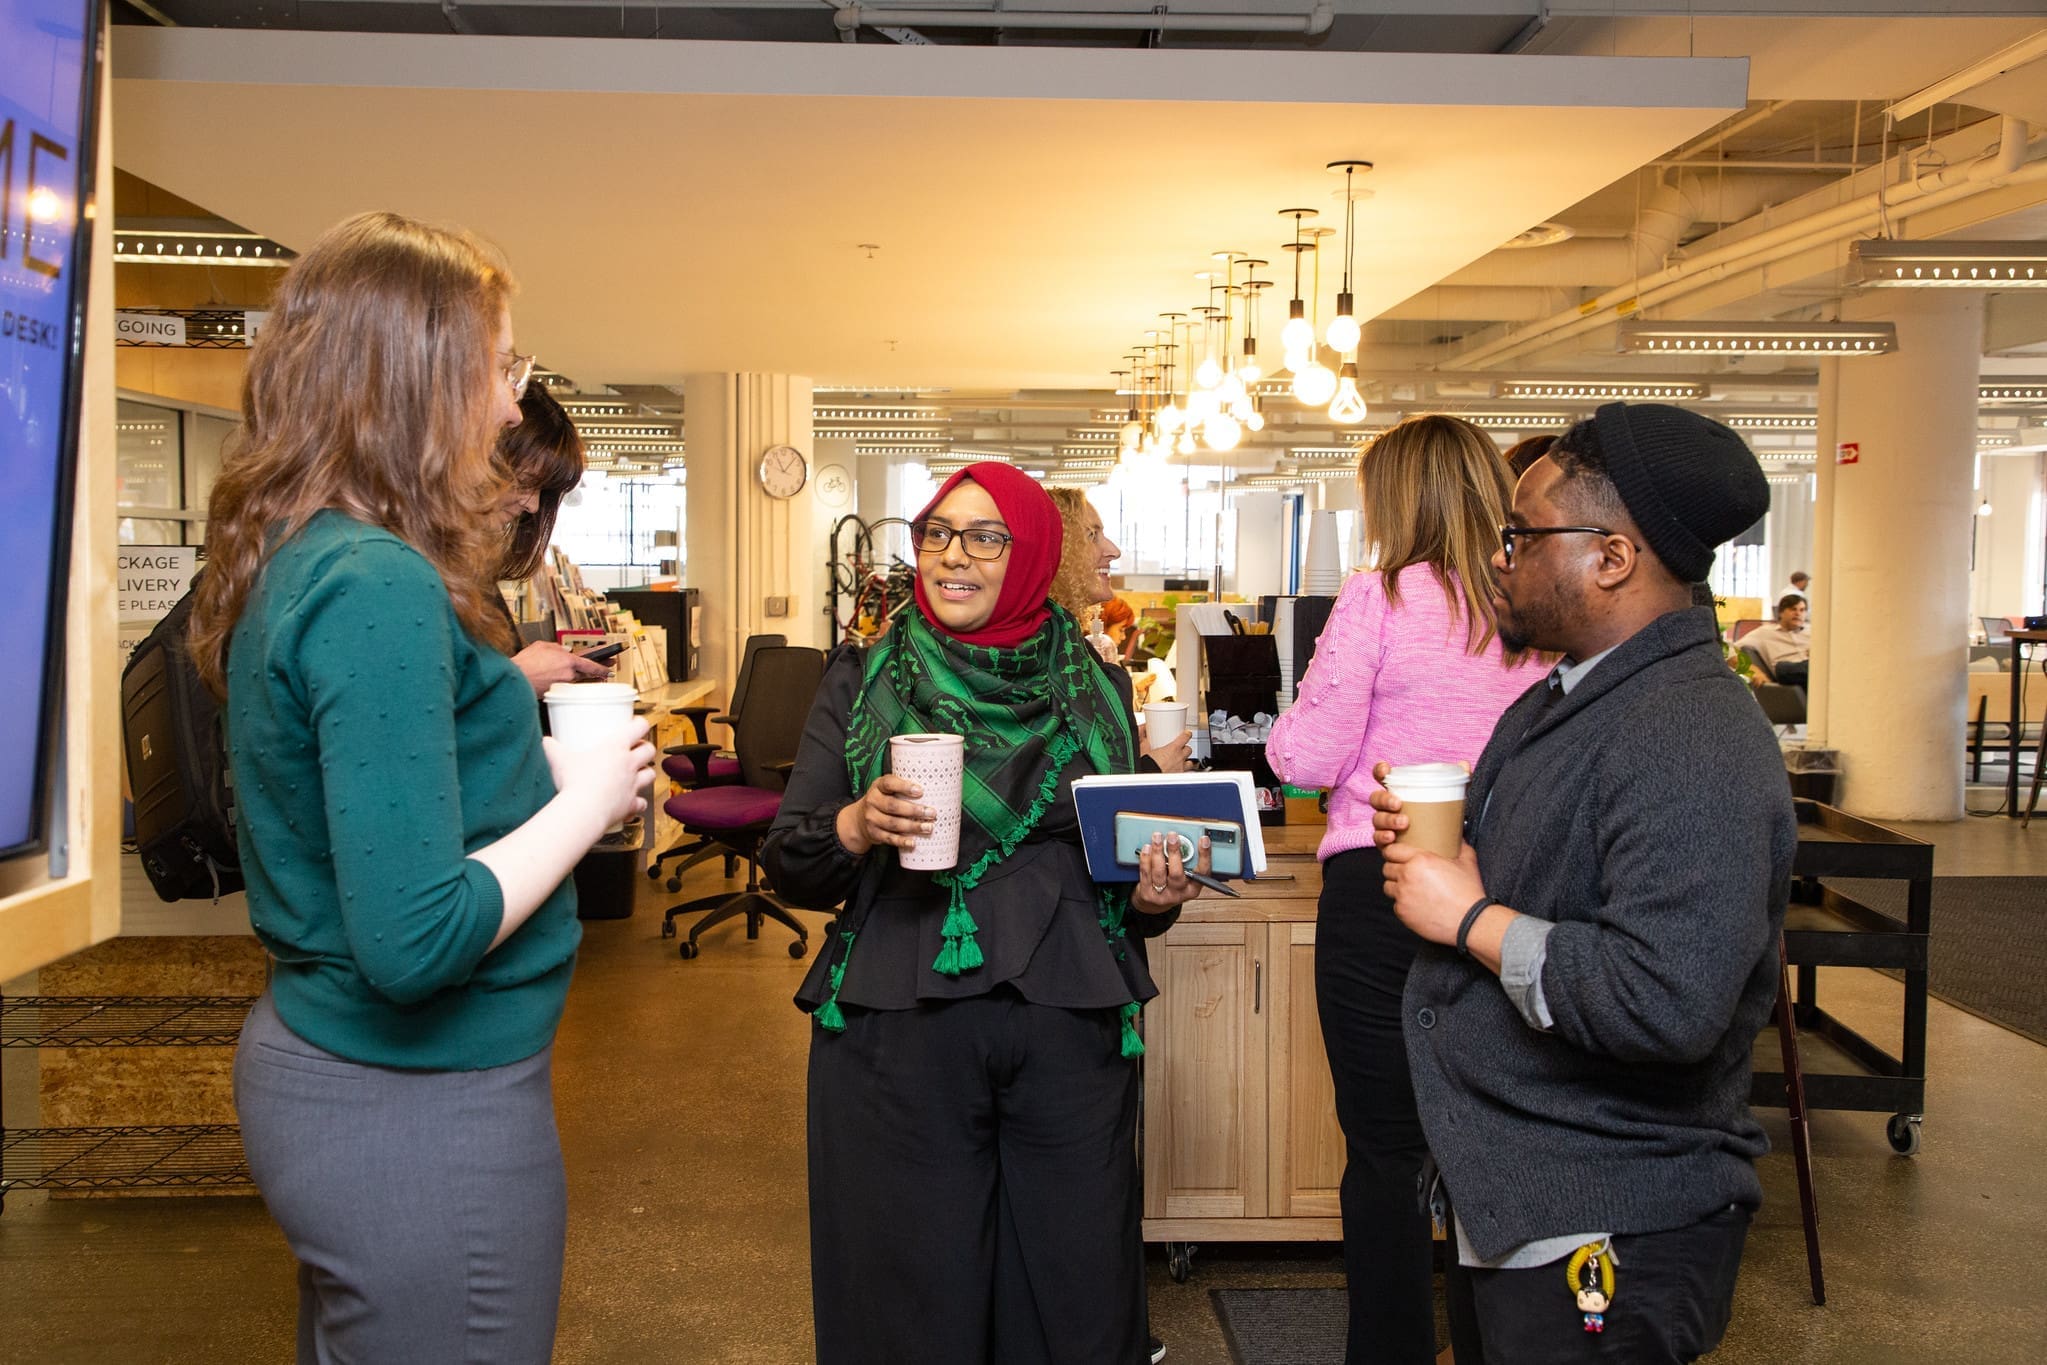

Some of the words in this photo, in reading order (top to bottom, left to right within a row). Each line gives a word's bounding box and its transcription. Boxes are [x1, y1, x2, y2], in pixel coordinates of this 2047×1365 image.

[3, 310, 58, 350] DESK!
[115, 319, 176, 336] GOING
[118, 556, 180, 570] CKAGE
[131, 600, 179, 611] PLEAS
